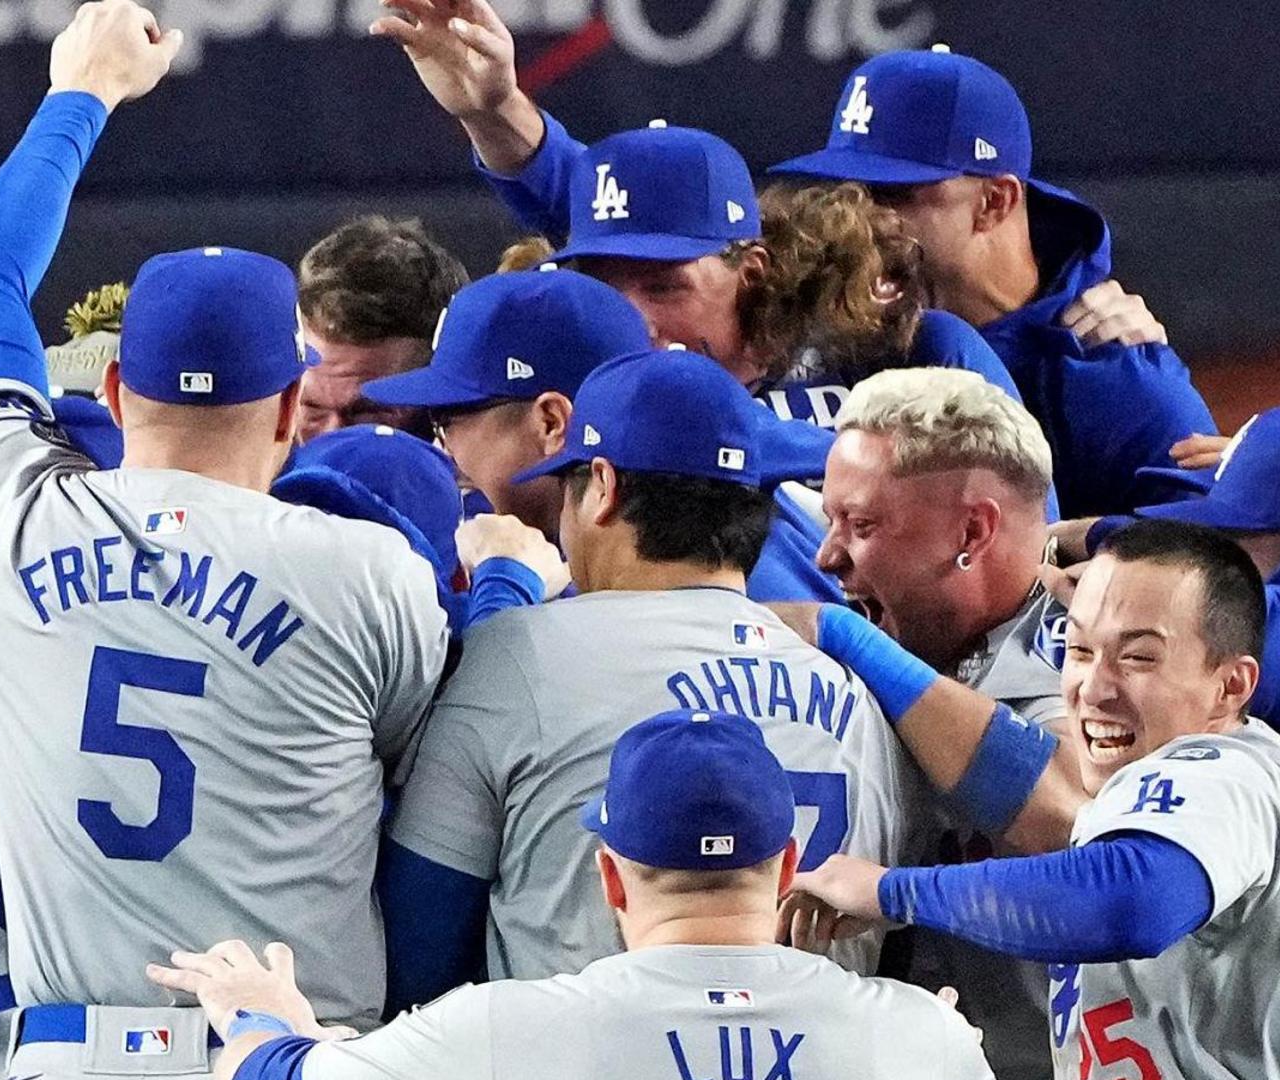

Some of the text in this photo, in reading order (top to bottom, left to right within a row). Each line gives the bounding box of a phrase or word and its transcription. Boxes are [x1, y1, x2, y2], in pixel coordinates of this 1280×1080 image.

[839, 75, 874, 135] LA
[591, 163, 630, 221] LA
[19, 535, 304, 667] FREEMAN
[666, 657, 856, 742] OHTANI
[77, 645, 208, 862] 5
[782, 769, 849, 873] 7
